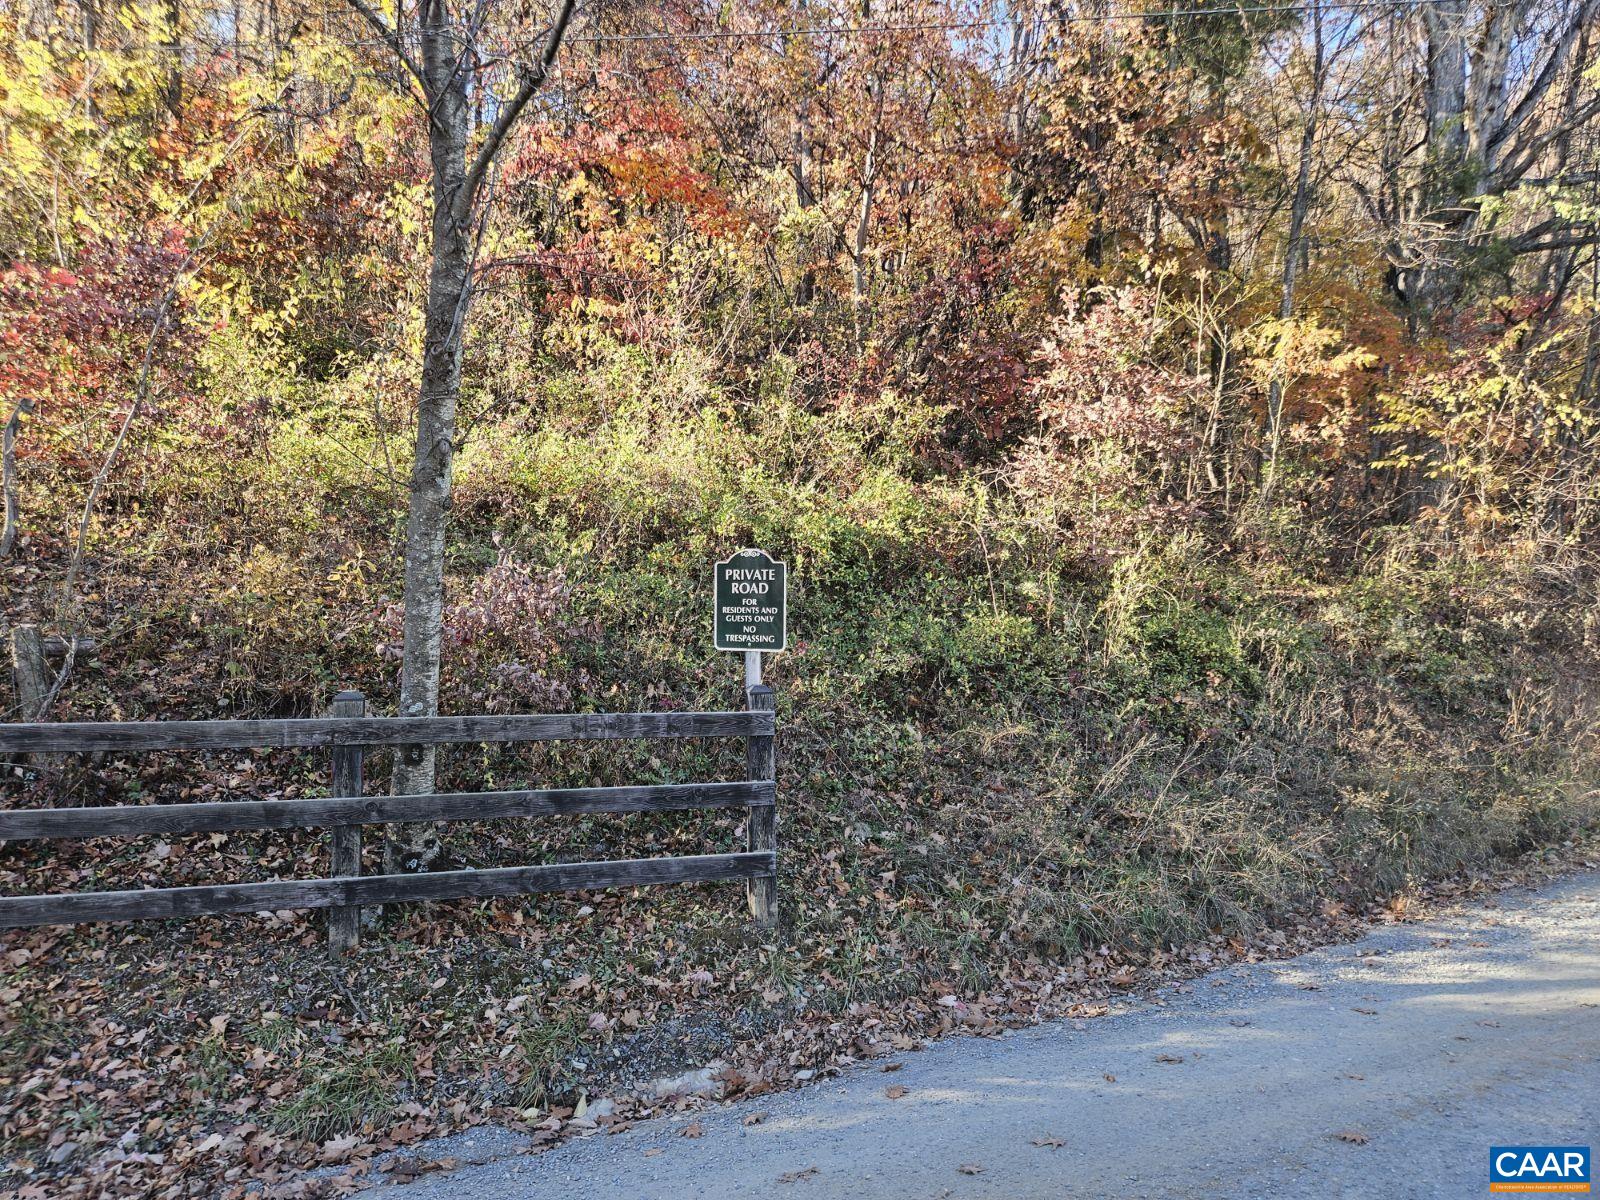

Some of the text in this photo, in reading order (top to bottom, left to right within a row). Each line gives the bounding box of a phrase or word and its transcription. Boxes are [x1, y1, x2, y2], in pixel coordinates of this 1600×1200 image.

[725, 569, 775, 580] PRIVATE
[731, 582, 769, 594] ROAD
[754, 615, 775, 623] ONLY
[743, 625, 756, 633] NO
[725, 634, 775, 643] TRESPASSING
